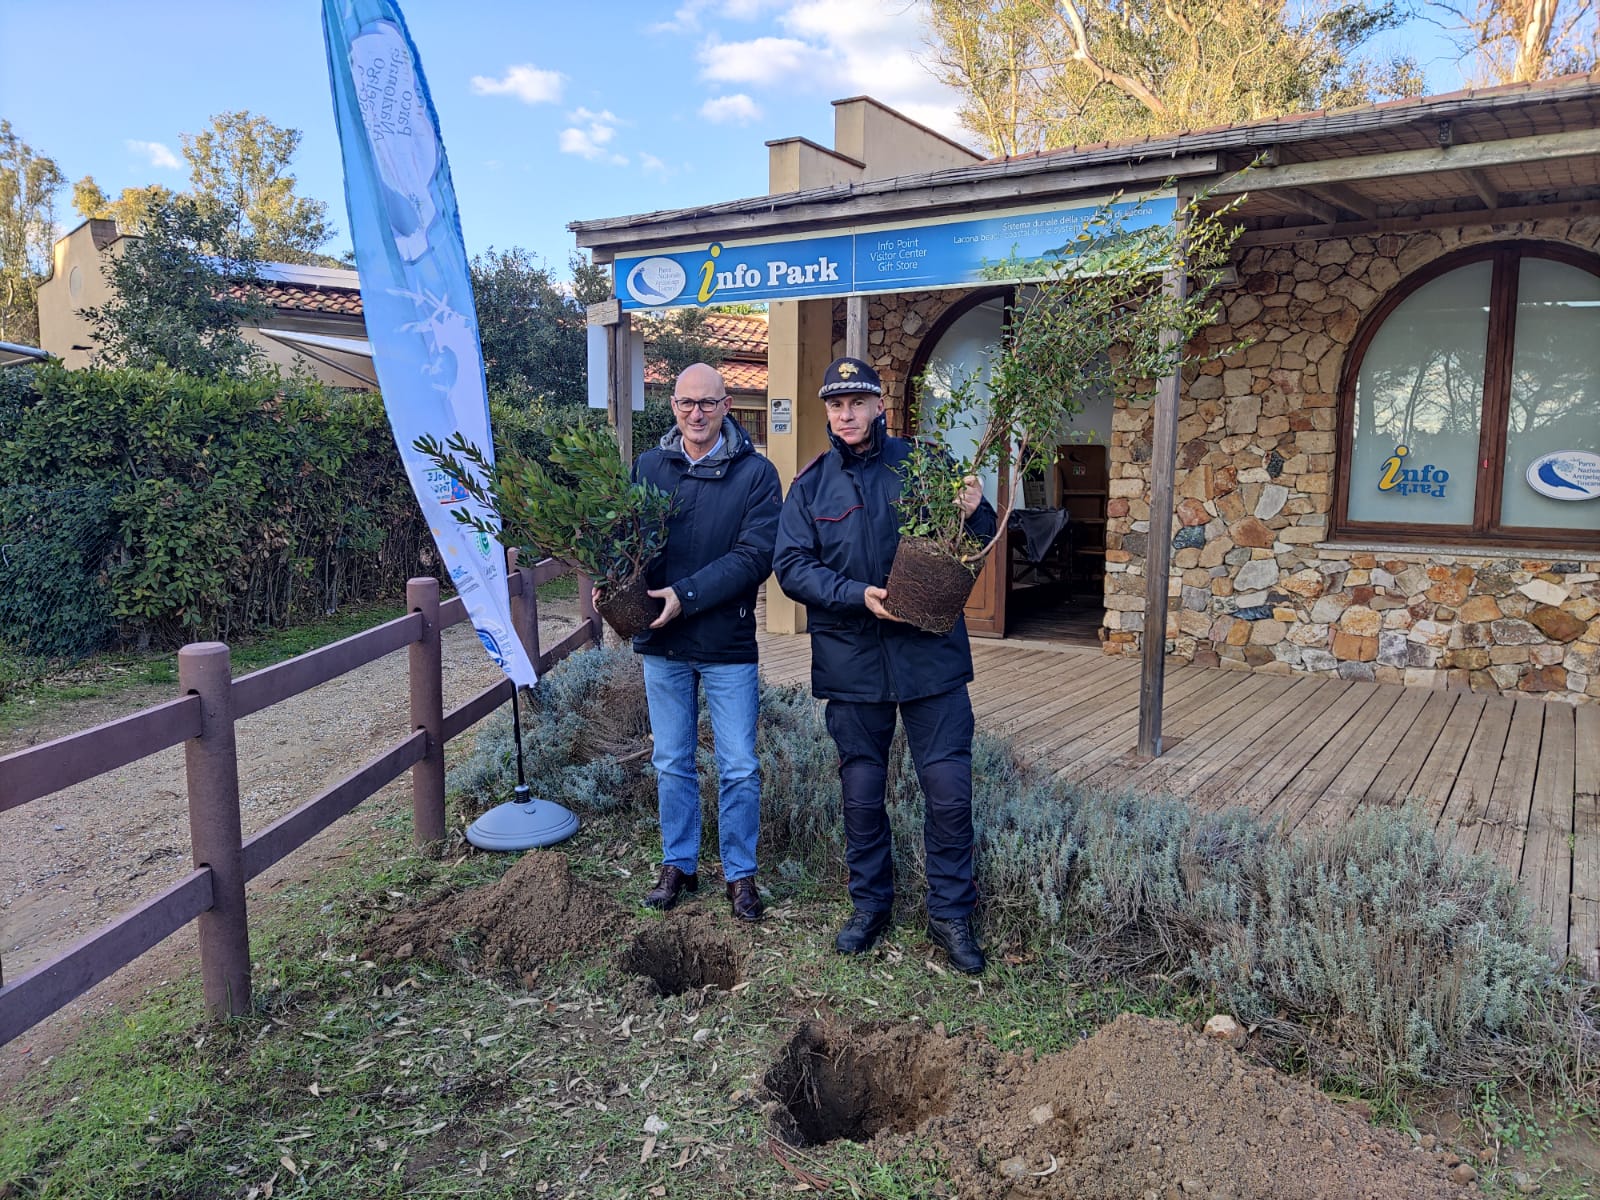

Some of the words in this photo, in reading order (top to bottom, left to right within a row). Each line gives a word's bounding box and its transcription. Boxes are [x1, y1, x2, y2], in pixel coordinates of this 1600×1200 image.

[1002, 221, 1031, 232] Sistema
[1033, 216, 1058, 228] dunale
[1060, 214, 1078, 225] della
[1115, 210, 1122, 218] di
[877, 239, 894, 251] Info
[897, 237, 919, 249] Point
[953, 235, 979, 244] Lacona
[1003, 229, 1029, 239] coastal
[870, 250, 897, 262] Visitor
[898, 248, 928, 259] Center
[877, 261, 894, 272] Gift
[896, 260, 918, 271] Store
[697, 245, 761, 303] info
[766, 256, 839, 287] Park
[1378, 445, 1450, 491] info
[1395, 483, 1446, 498] Park
